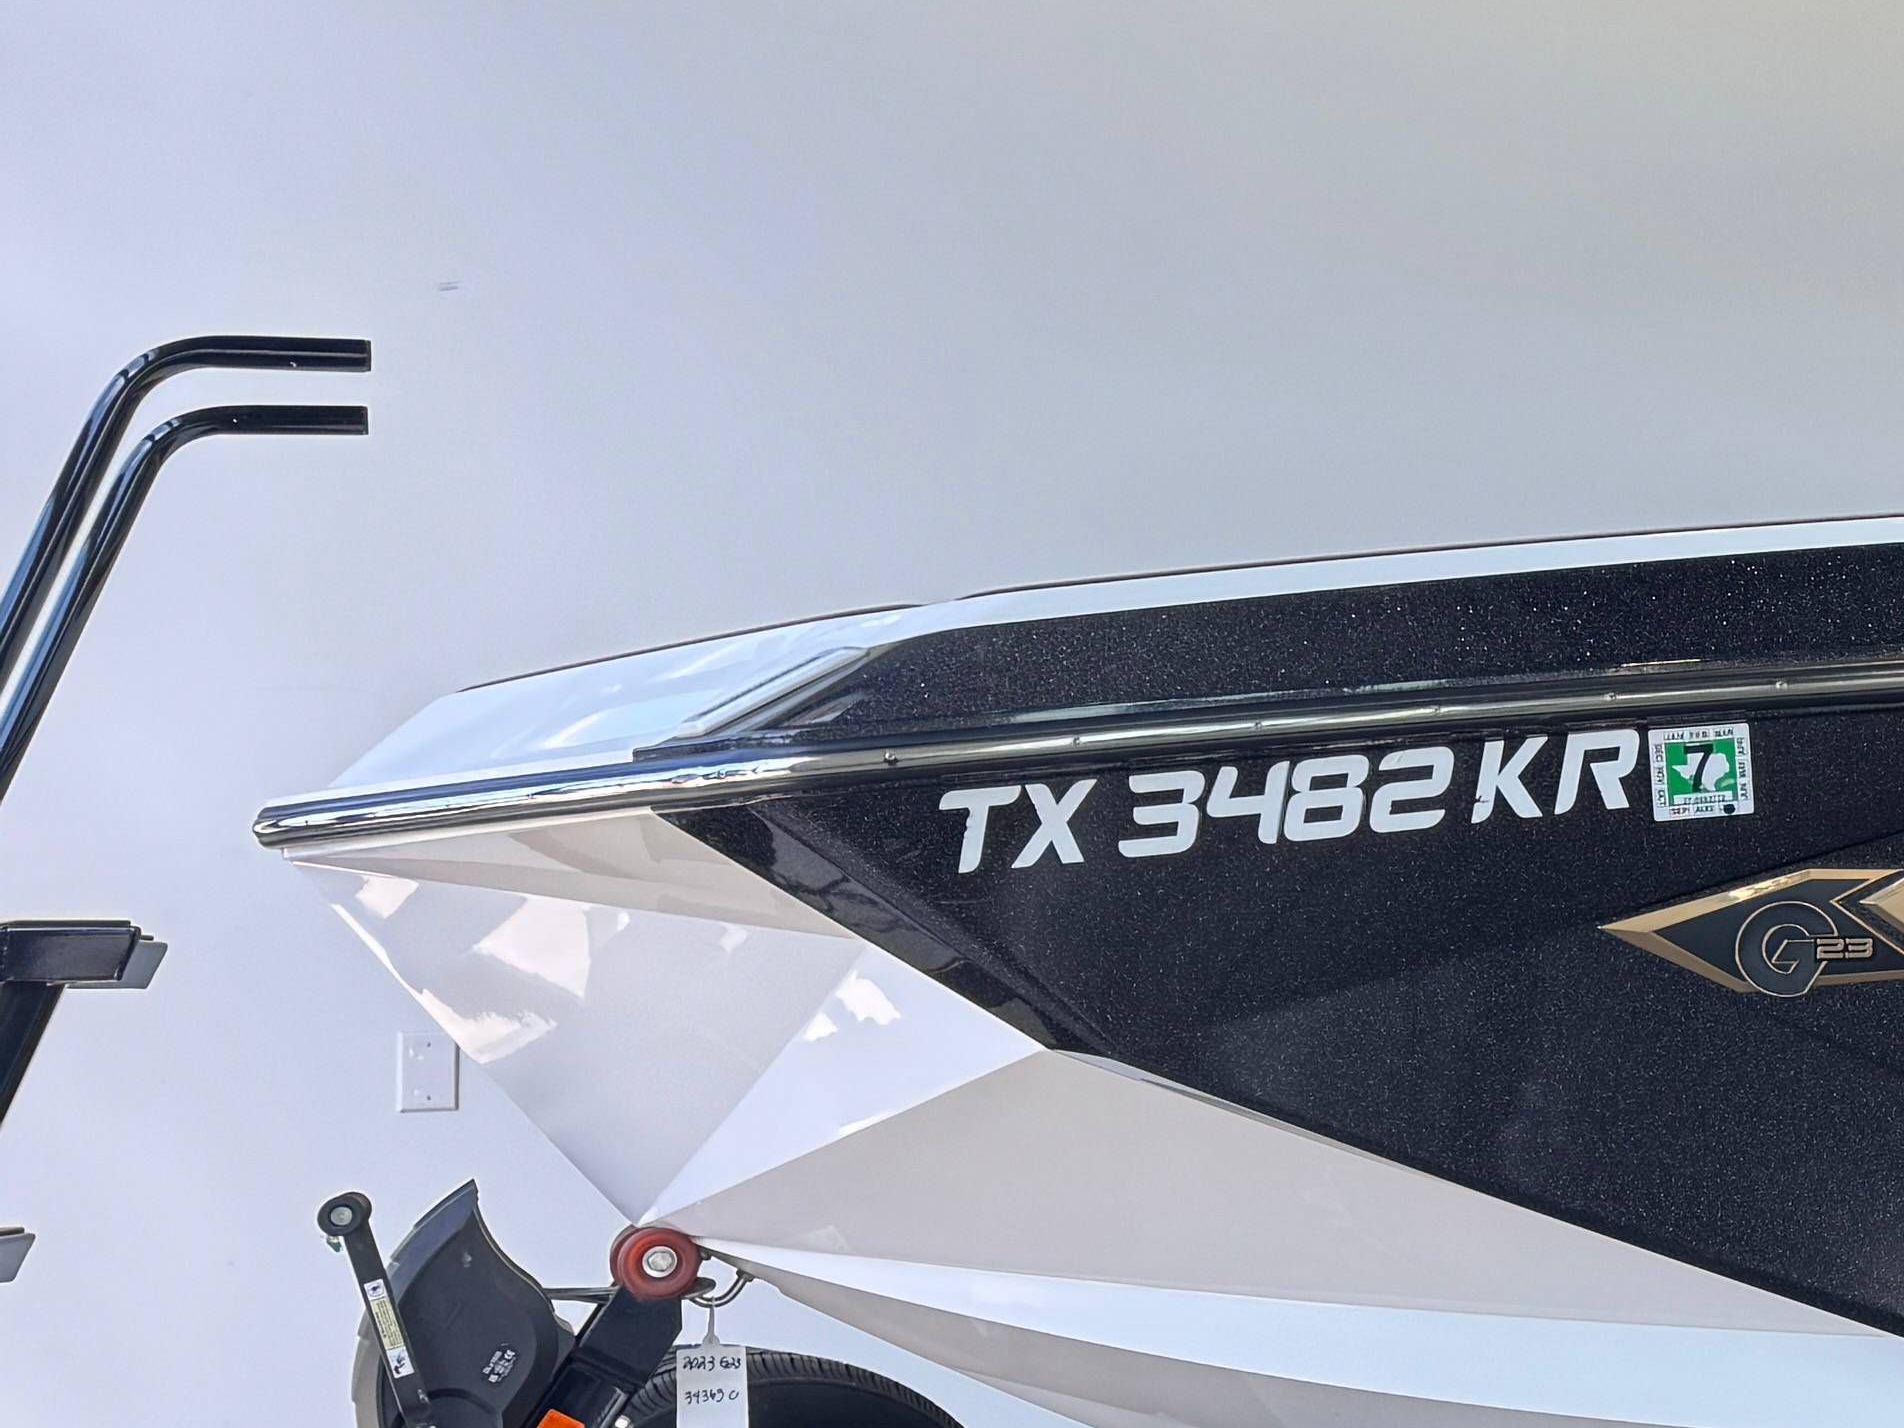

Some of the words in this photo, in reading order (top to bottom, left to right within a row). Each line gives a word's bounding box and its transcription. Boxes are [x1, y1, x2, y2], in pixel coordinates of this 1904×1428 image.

[937, 778, 1097, 874] TX
[1117, 746, 1456, 858] 3482
[1683, 743, 1714, 793] 7
